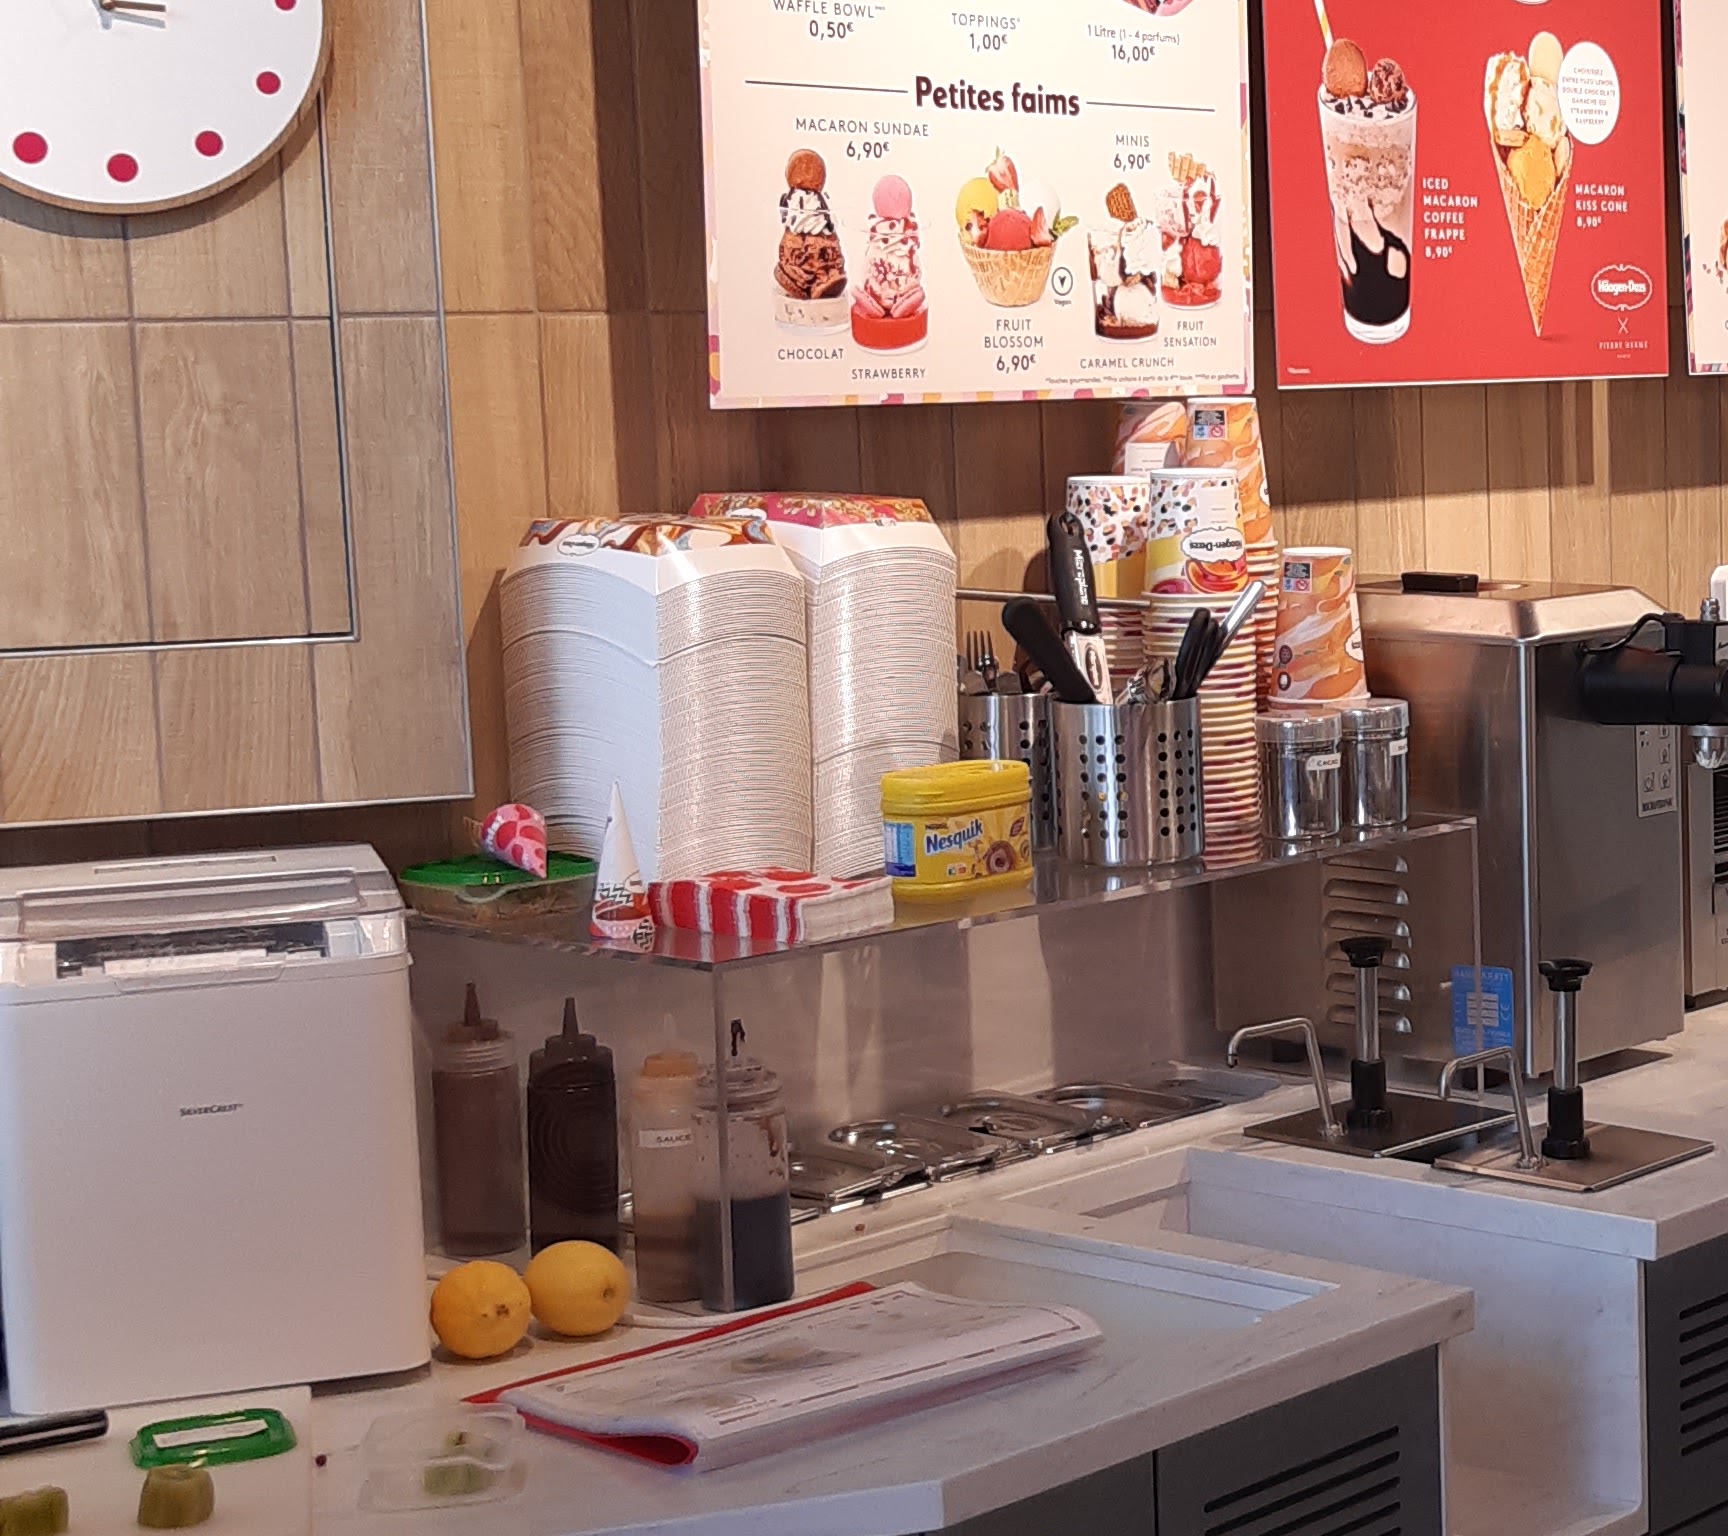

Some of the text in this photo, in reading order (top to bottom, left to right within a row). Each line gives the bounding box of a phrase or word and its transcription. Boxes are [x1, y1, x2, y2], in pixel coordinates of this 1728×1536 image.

[808, 20, 854, 40] 0,50€
[1134, 31, 1141, 41] 4
[969, 32, 1008, 51] 1,00€
[1111, 44, 1156, 62] 16,00€
[915, 76, 1081, 115] Petites faims
[796, 118, 930, 137] MACARON SUNDAE
[1115, 133, 1150, 148] MINIS
[846, 140, 890, 159] 6,90€
[1113, 151, 1151, 170] 6,90€
[1422, 177, 1449, 190] ICED
[1575, 184, 1625, 196] MACARON
[1423, 195, 1478, 208] MACARON
[1576, 200, 1628, 213] KISS CONE
[1424, 212, 1464, 224] COFFEE
[995, 318, 1031, 332] FRUIT
[1176, 320, 1204, 331] FRUIT
[984, 335, 1044, 349] BLOSSOM
[1163, 335, 1217, 347] SENSATION
[777, 347, 844, 360] CHOCOLAT
[995, 354, 1036, 373] 6,90€
[1080, 356, 1175, 369] CARAMEL CRUNCH
[851, 367, 926, 379] STRAWBERRY
[925, 819, 983, 854] Nesquik
[657, 1134, 691, 1142] SAUCE
